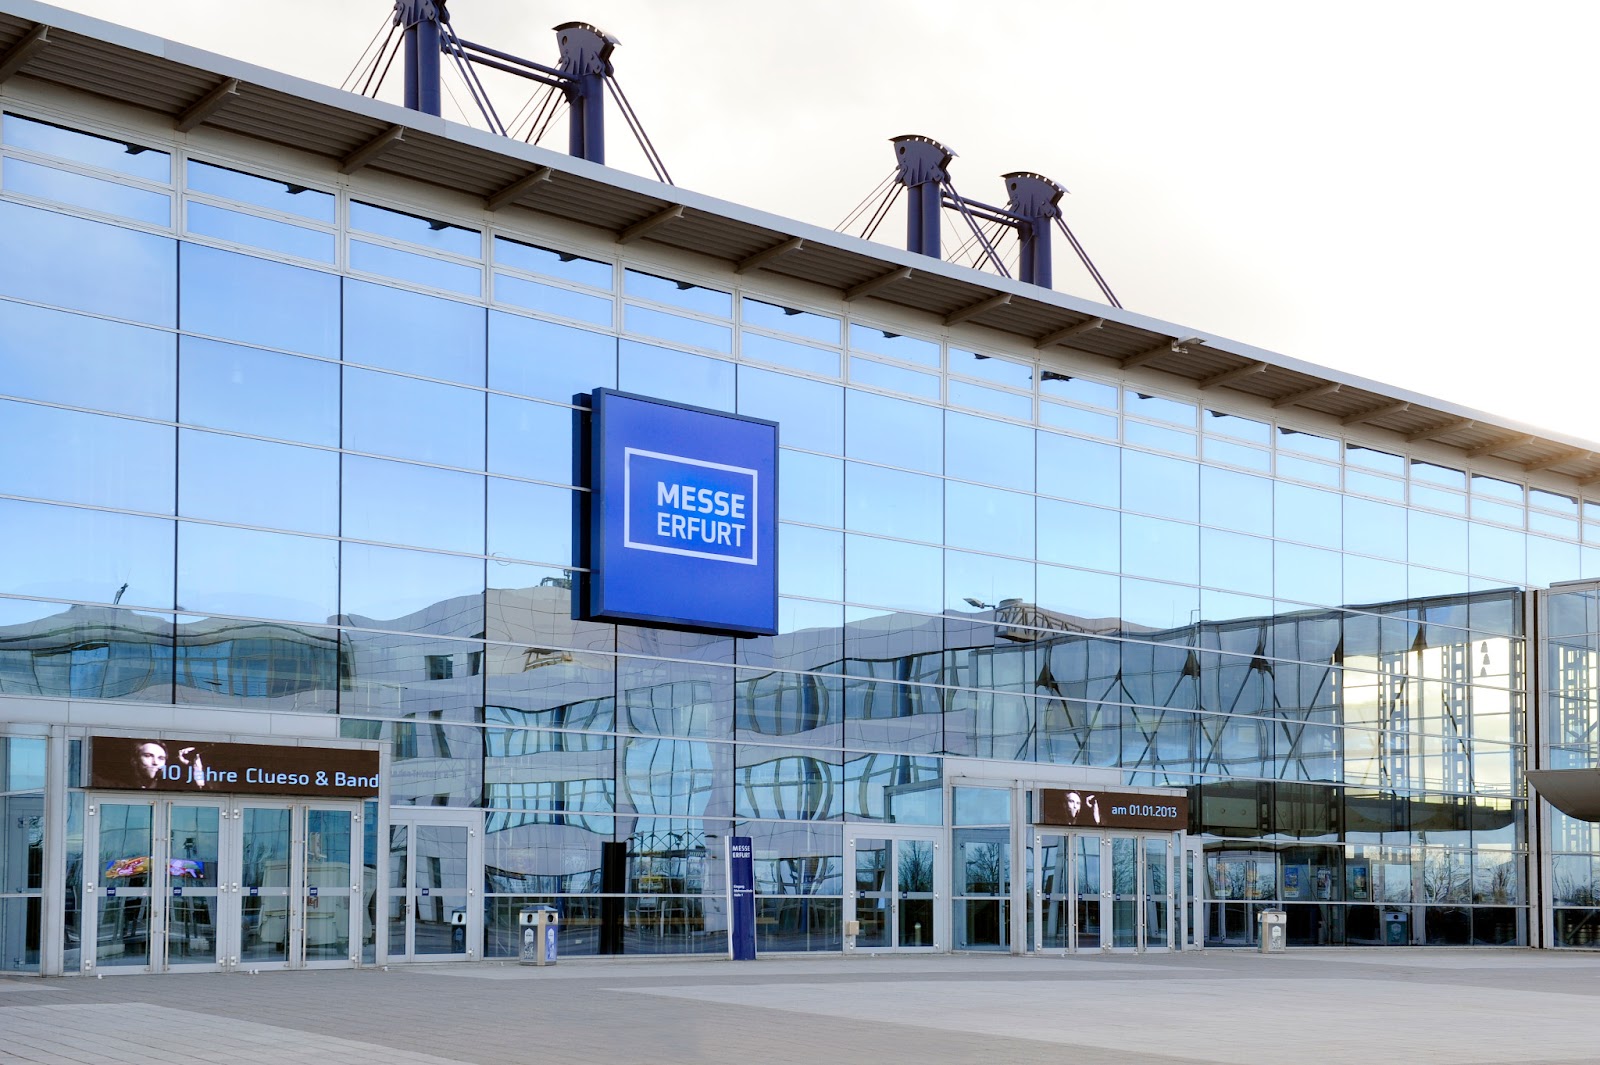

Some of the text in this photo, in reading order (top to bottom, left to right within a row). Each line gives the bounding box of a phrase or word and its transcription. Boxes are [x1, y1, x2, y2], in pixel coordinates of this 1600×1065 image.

[657, 481, 745, 519] MESSE
[657, 511, 746, 547] ERFURT
[160, 765, 181, 780] 10
[246, 767, 310, 786] Clueso
[315, 771, 329, 786] &
[335, 771, 379, 787] Band
[1111, 804, 1177, 818] am 01.01.2013
